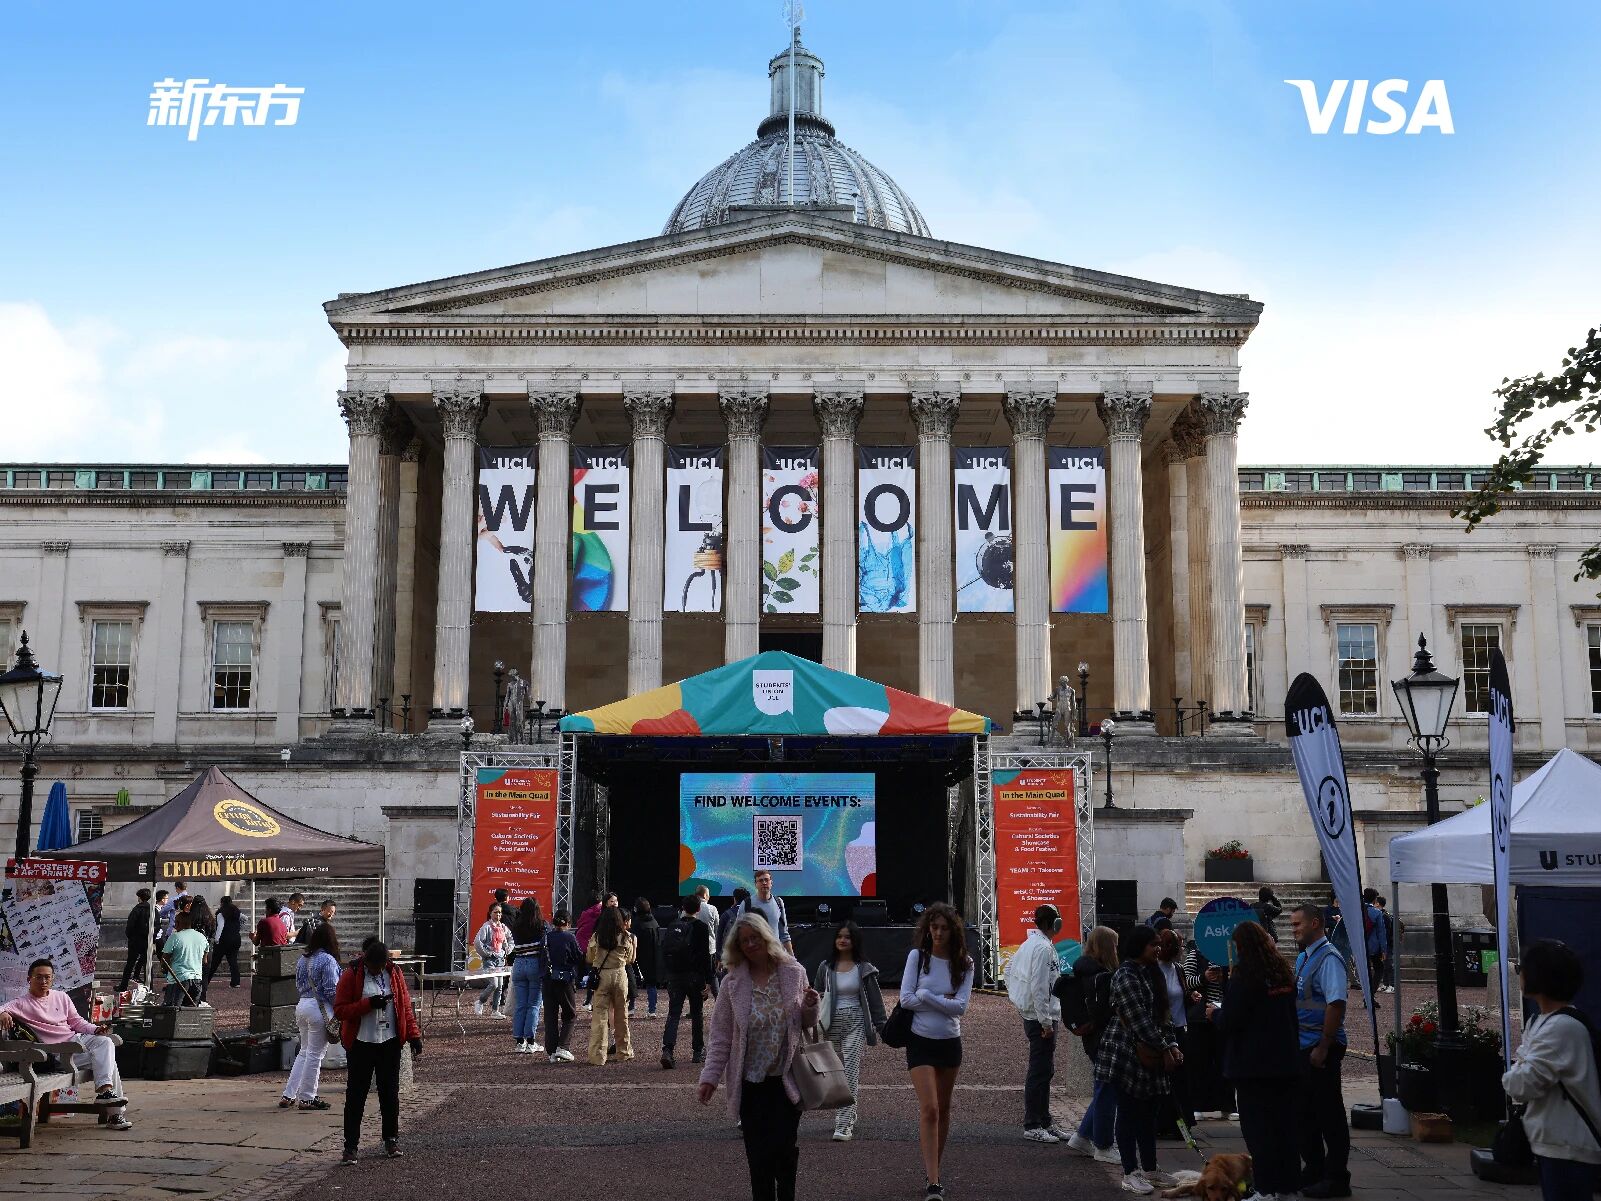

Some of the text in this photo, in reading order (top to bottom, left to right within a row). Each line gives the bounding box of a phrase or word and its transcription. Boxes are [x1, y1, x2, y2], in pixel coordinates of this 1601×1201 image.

[498, 458, 531, 470] UCL
[592, 458, 626, 470] UCL
[686, 458, 719, 470] UCL
[781, 459, 815, 470] UCL
[877, 458, 911, 470] UCL
[972, 458, 1006, 470] UCL
[1067, 458, 1102, 470] UCL
[1298, 705, 1331, 733] UCL
[1045, 791, 1065, 799] Quad
[694, 796, 861, 807] FIND WELCOME EVENTS:
[33, 863, 75, 872] POSTERS
[41, 869, 75, 878] PRINTS
[77, 864, 100, 878] £6
[163, 861, 222, 878] CEYLON
[226, 858, 278, 876] KOTHU
[1204, 924, 1230, 938] Ask
